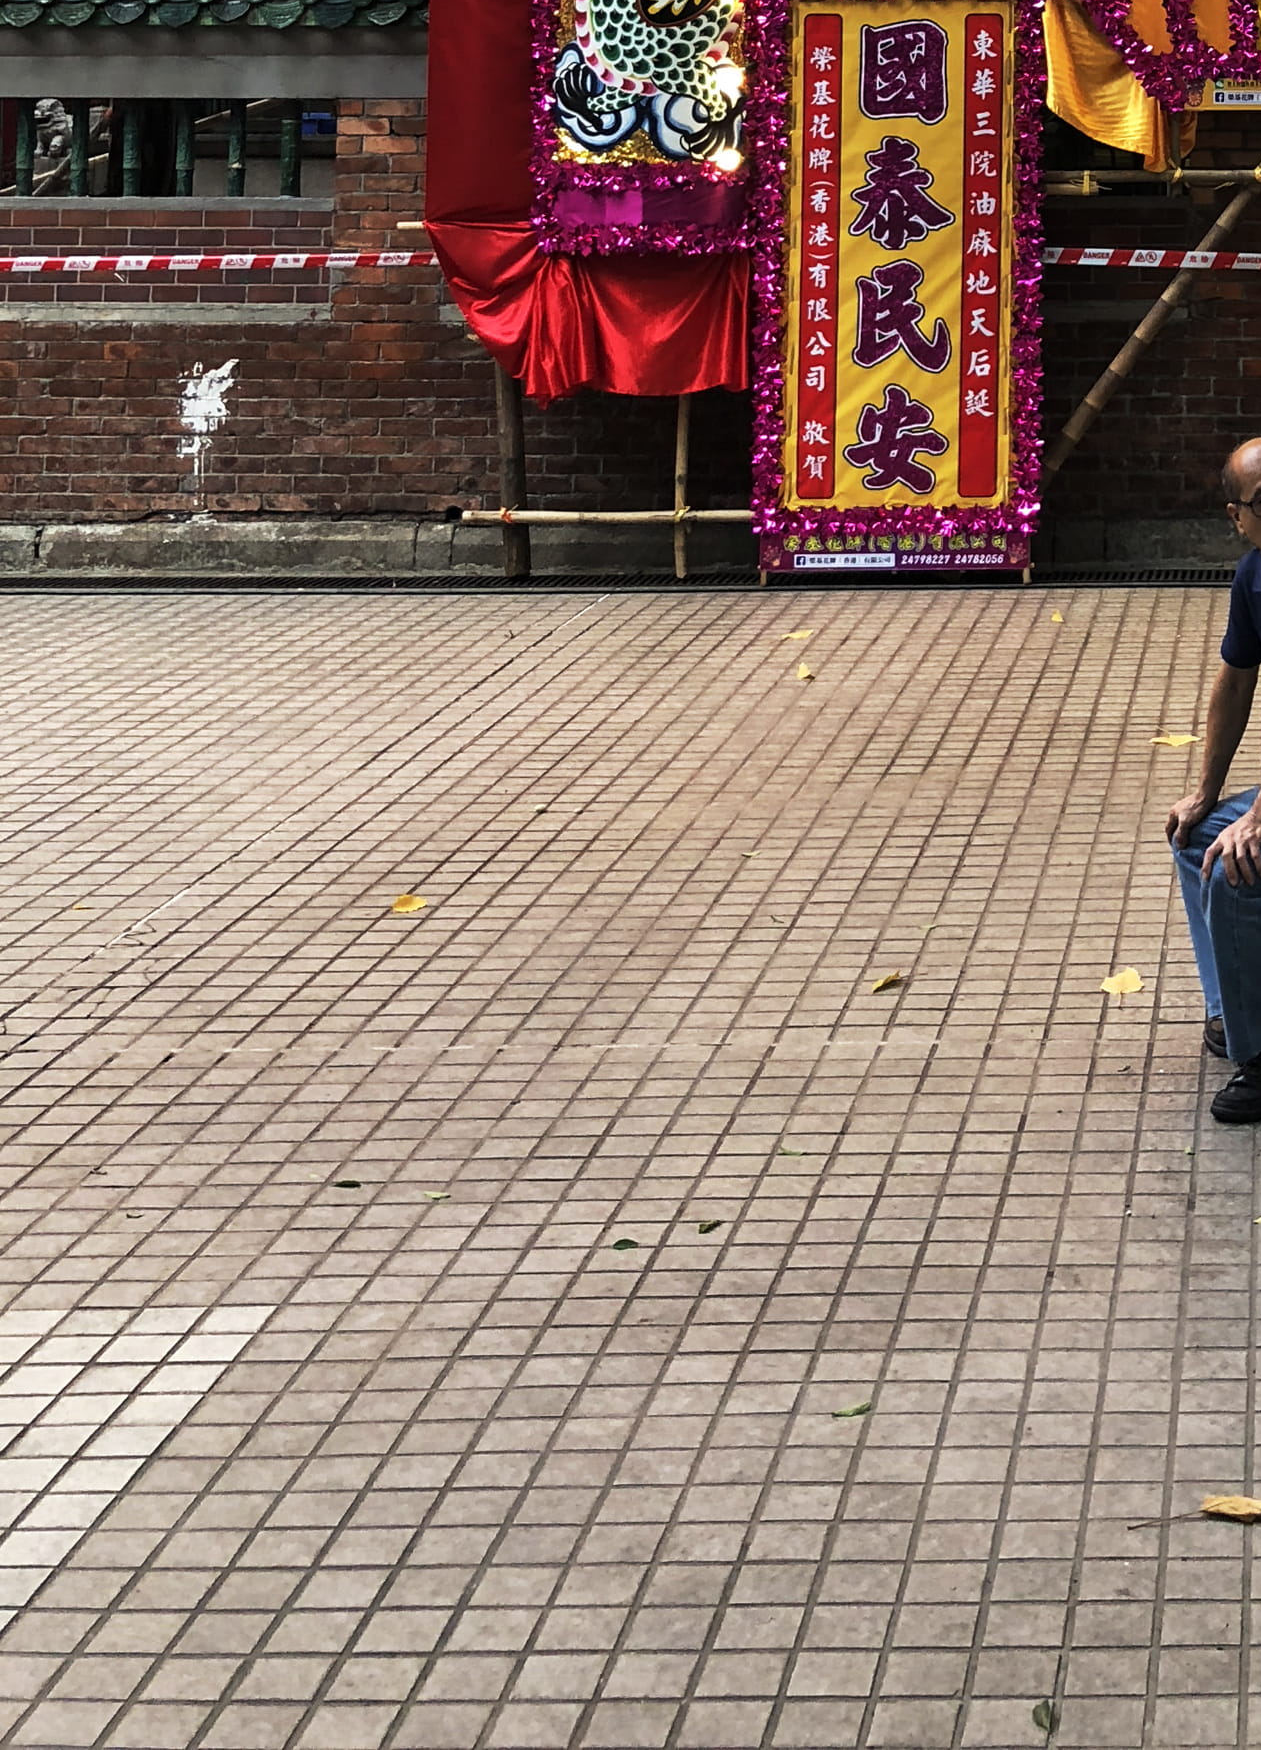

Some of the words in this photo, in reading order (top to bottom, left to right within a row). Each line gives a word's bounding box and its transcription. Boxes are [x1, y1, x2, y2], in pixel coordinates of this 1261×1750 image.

[843, 18, 954, 494] 國泰民安
[965, 28, 999, 418] 東華三院油麻地天后誕
[900, 553, 951, 565] 24798227
[954, 553, 1005, 565] 24782056
